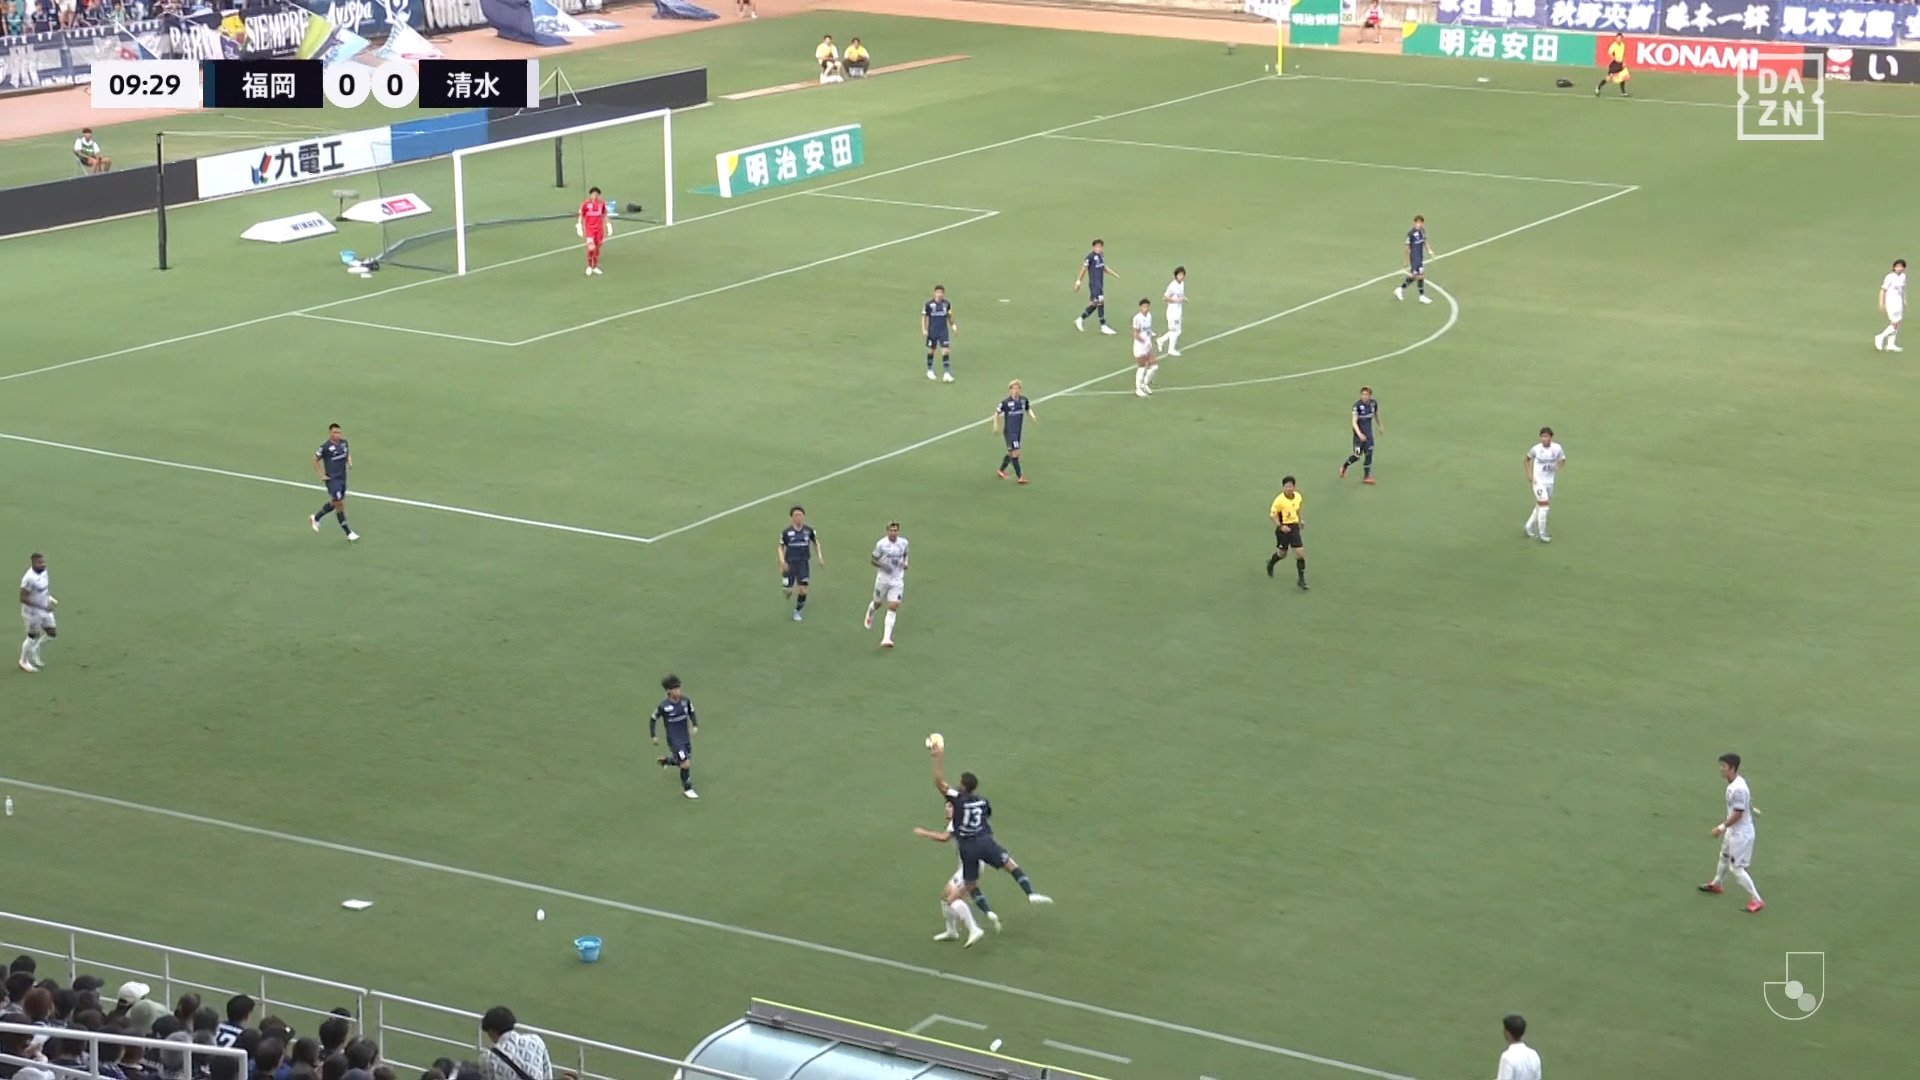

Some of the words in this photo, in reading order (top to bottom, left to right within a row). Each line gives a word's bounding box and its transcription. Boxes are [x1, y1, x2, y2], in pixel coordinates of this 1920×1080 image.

[1438, 28, 1559, 63] 明治安田
[1636, 42, 1760, 71] KONAMI
[1868, 53, 1899, 80] い
[274, 140, 345, 180] 九電工
[745, 133, 853, 187] 明治安田
[962, 806, 983, 828] 13
